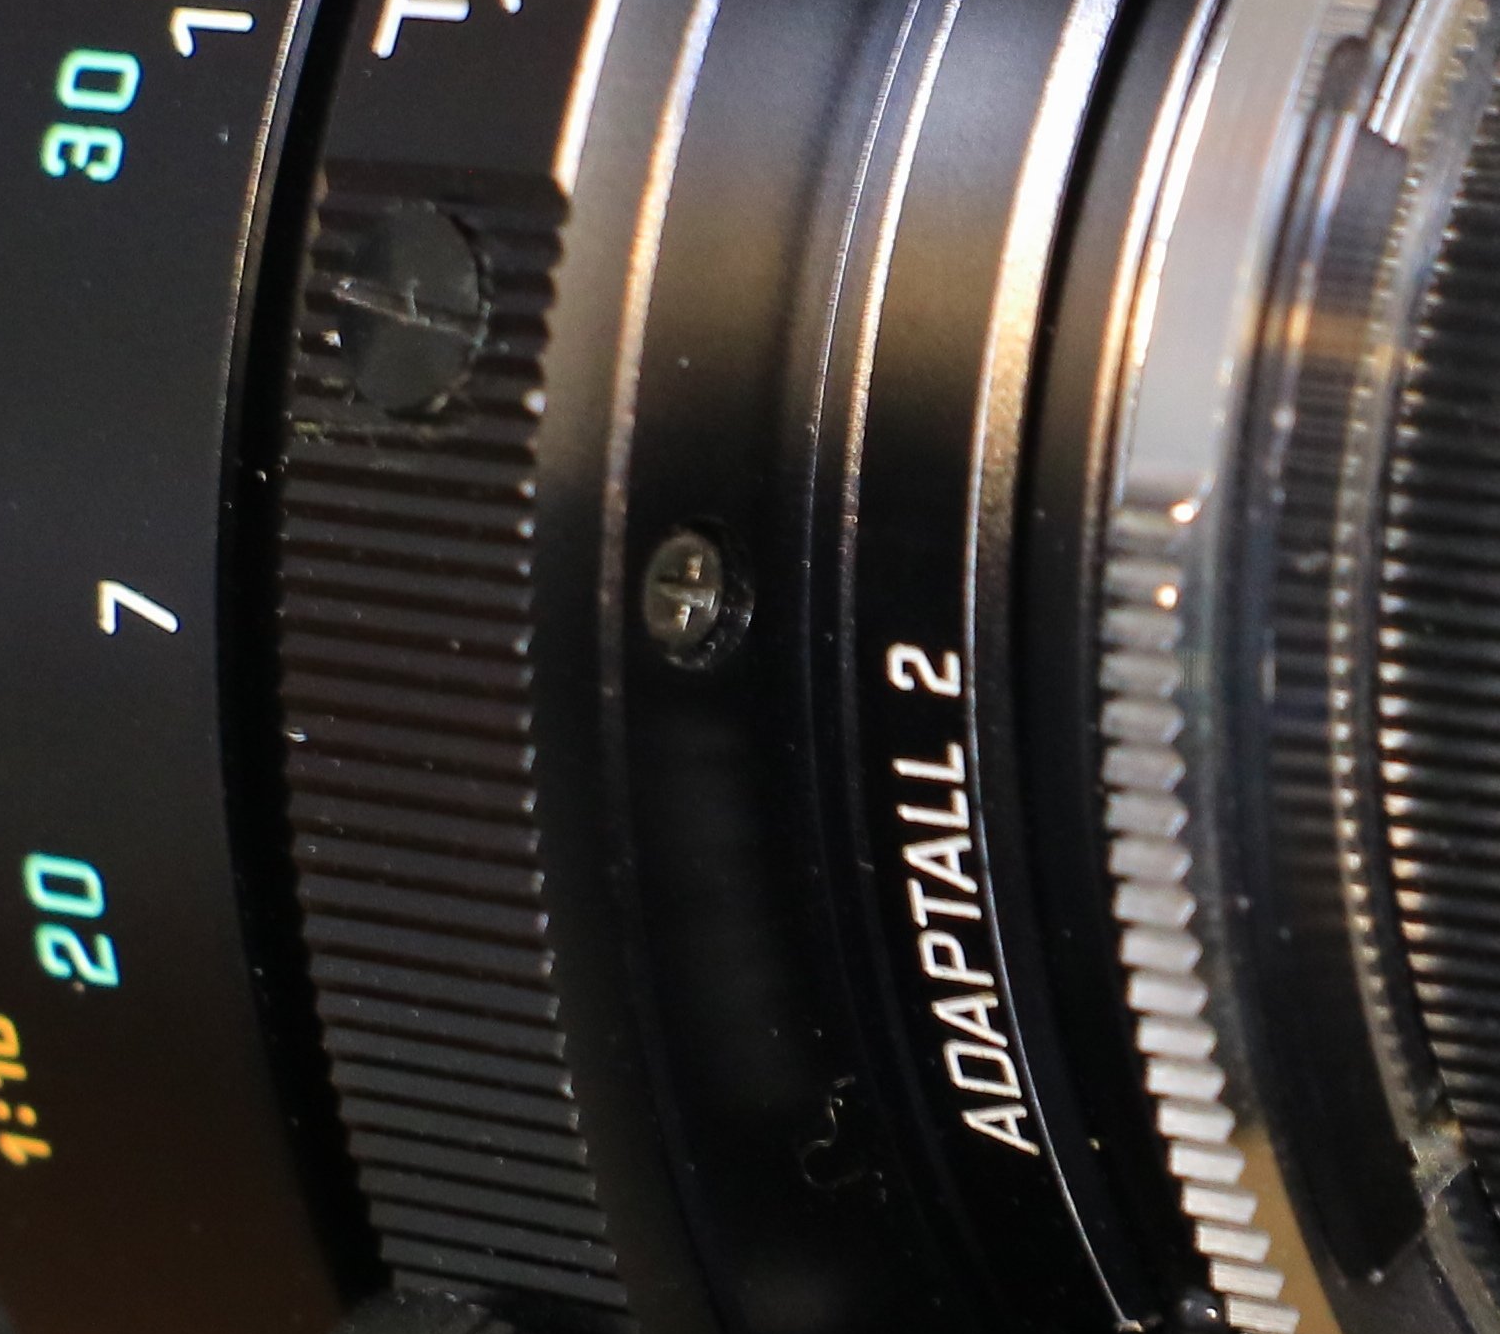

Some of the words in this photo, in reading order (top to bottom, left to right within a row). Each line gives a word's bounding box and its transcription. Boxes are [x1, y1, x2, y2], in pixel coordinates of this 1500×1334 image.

[41, 49, 141, 181] 30
[98, 581, 179, 635] 7
[887, 643, 961, 697] 2
[23, 853, 119, 986] 20
[893, 741, 1039, 1156] ADAPTALL
